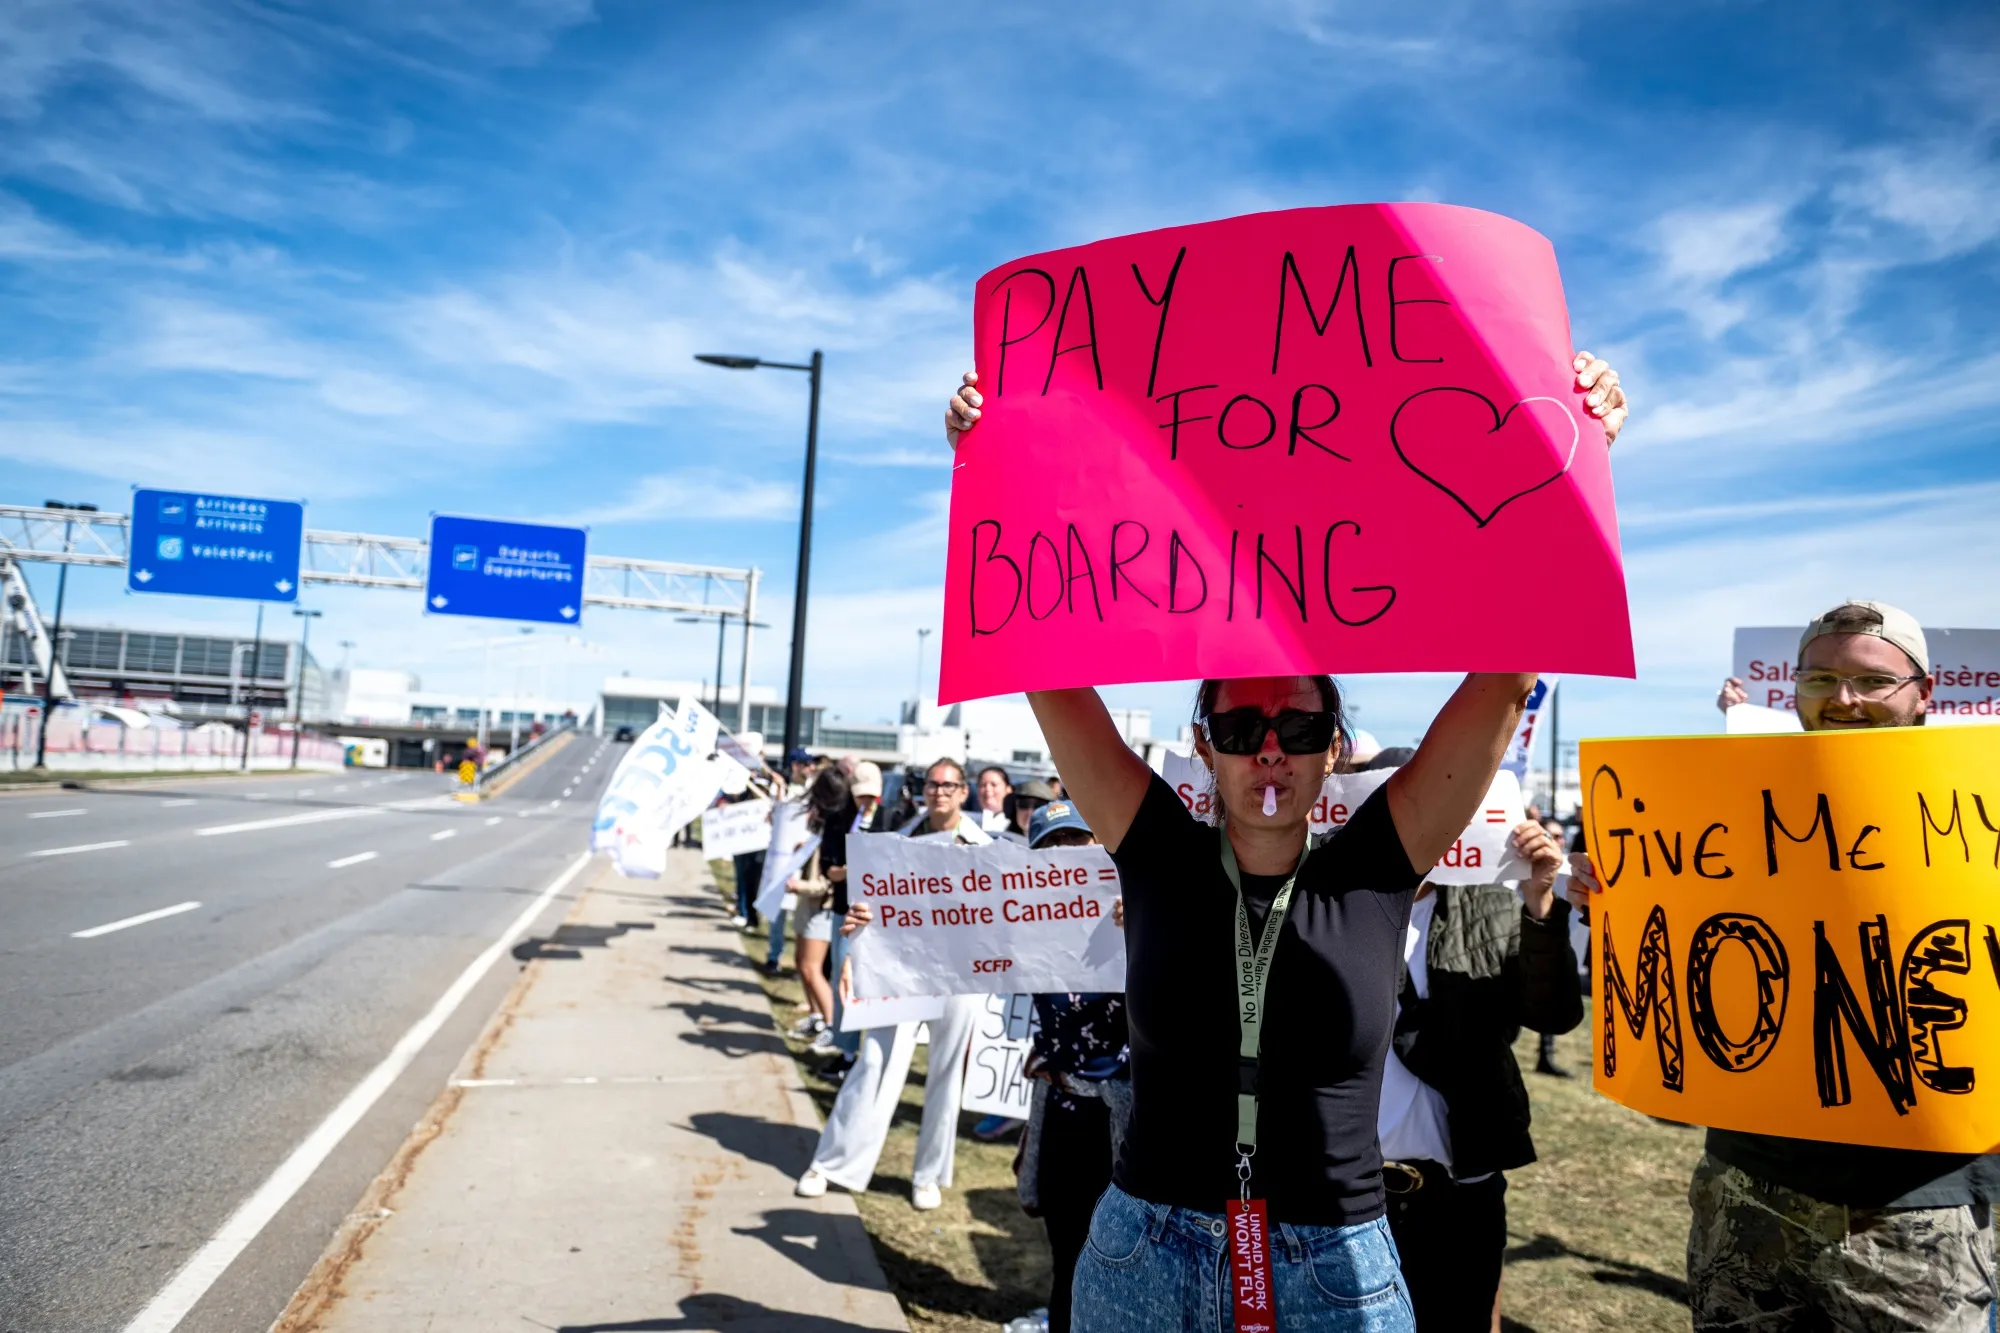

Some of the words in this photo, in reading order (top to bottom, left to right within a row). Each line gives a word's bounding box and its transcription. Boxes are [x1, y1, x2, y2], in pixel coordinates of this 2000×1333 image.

[990, 246, 1187, 398] PAY
[1271, 245, 1451, 374] ME
[1156, 383, 1352, 462] FOR
[192, 543, 274, 563] ValetParc
[971, 519, 1397, 638] BOARDING
[1928, 664, 2000, 687] isère
[1311, 796, 1348, 824] de
[862, 872, 953, 897] Salaires
[962, 869, 992, 893] de
[1002, 864, 1088, 890] misère
[1098, 868, 1116, 881] =
[880, 904, 923, 928] Pas
[932, 902, 994, 925] notre
[1002, 895, 1100, 923] Canada
[972, 959, 1013, 973] SCFP
[1241, 961, 1255, 997] More
[1243, 1002, 1257, 1024] No
[1235, 1213, 1251, 1271] WON'T
[1250, 1213, 1263, 1264] UNPAID
[1239, 1276, 1255, 1309] FLY
[1253, 1267, 1268, 1310] WORK
